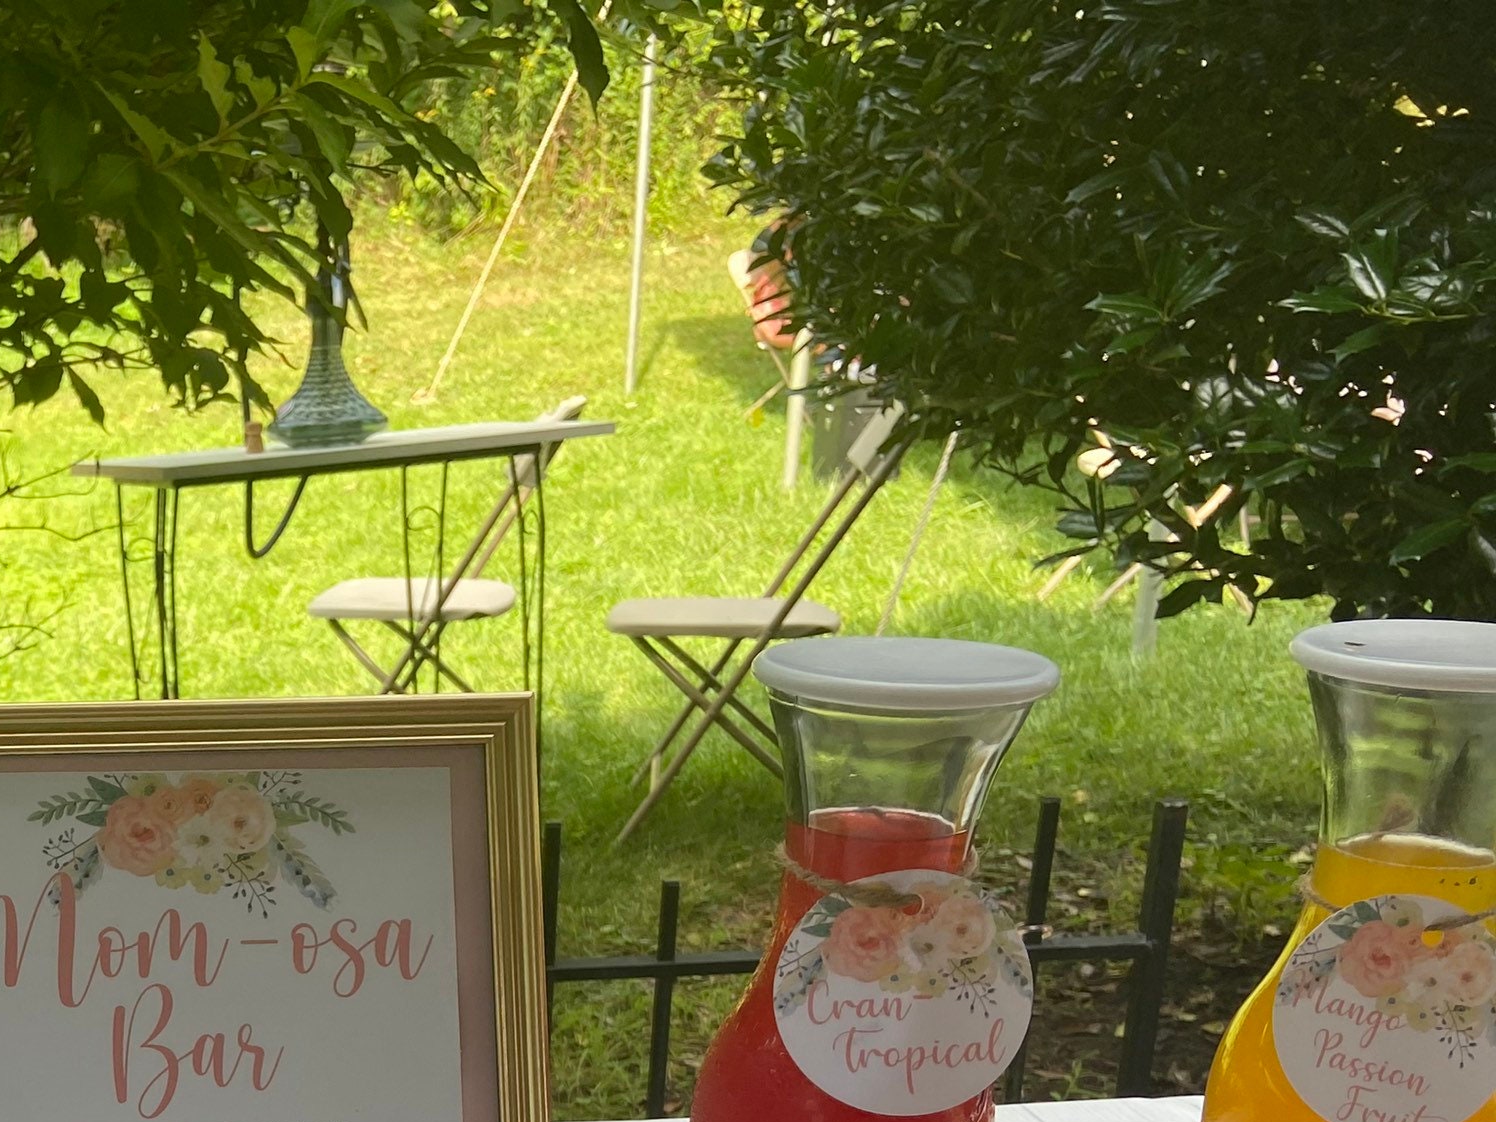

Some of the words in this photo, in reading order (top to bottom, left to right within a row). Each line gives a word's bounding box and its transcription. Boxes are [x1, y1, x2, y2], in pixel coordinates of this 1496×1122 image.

[1291, 976, 1407, 1048] Mango
[112, 983, 284, 1119] Bar
[833, 1018, 1006, 1095] Tropical
[1314, 1029, 1431, 1096] Passion
